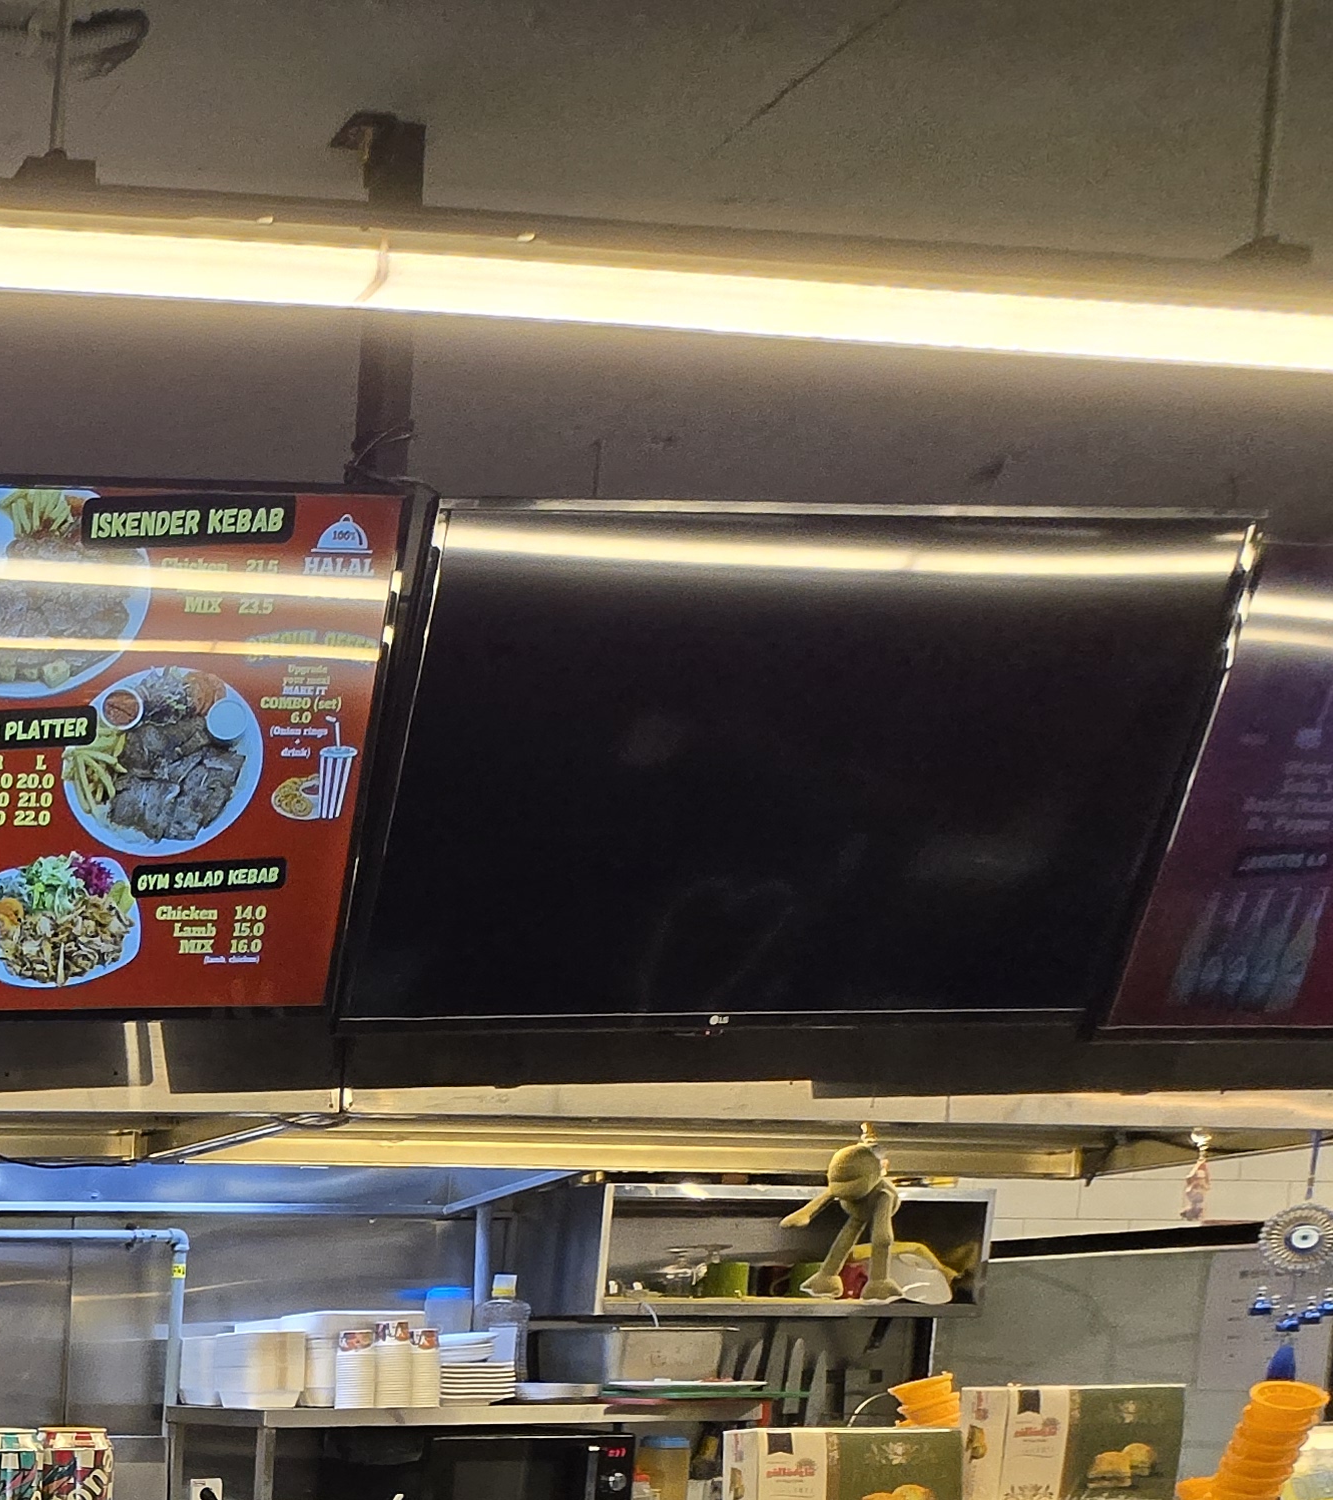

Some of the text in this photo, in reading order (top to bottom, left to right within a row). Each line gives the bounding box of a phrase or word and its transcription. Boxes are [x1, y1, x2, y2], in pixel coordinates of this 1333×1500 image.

[90, 507, 285, 540] ISKENDER KEBAB
[4, 717, 88, 741] PLATTER
[16, 772, 54, 789] 20.0
[137, 867, 279, 892] GYM SALAD KEBAB
